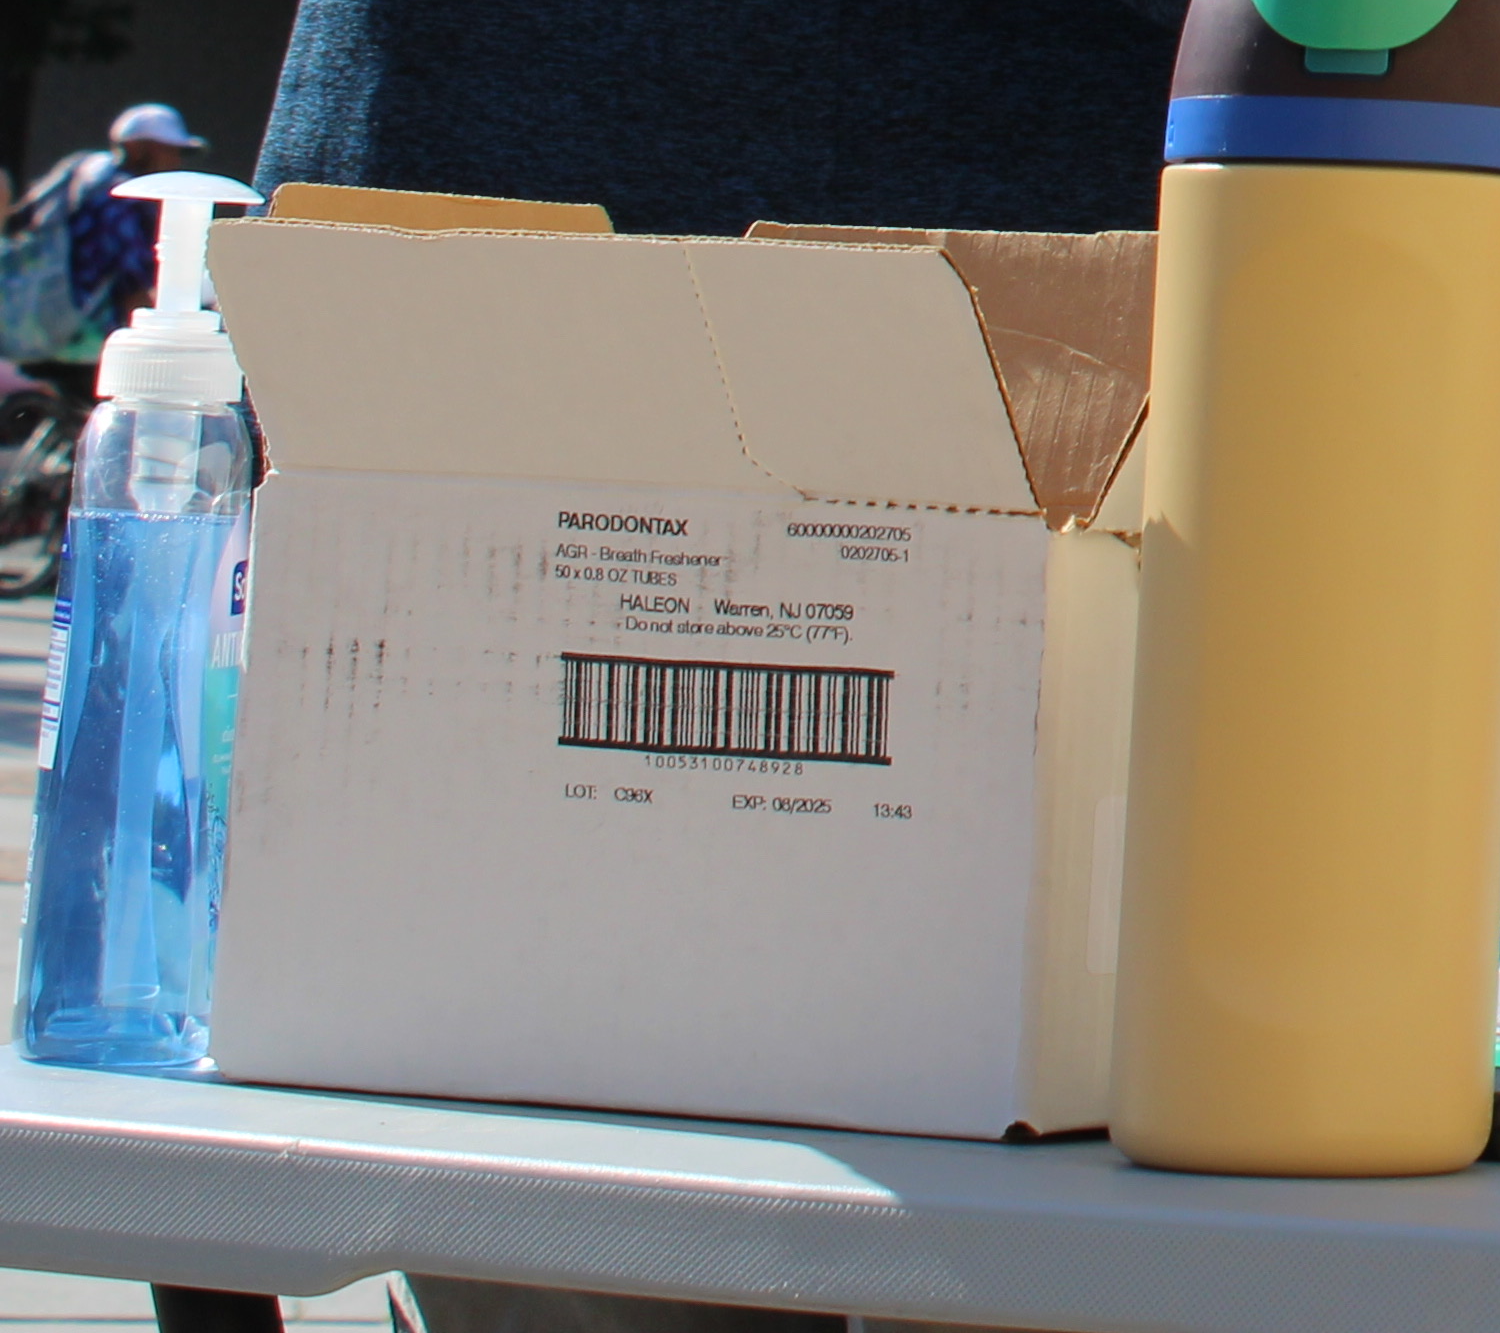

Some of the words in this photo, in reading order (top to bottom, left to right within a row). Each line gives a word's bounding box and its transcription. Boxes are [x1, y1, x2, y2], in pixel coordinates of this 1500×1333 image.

[558, 511, 689, 536] PARODONTAX
[787, 522, 912, 542] 60000000202705
[555, 543, 588, 559] AGR
[600, 546, 647, 562] Breath
[651, 550, 722, 567] Freshener
[841, 545, 909, 563] 0202705-1
[555, 564, 571, 579] 50
[573, 569, 580, 579] x
[584, 566, 604, 581] 0.8
[607, 568, 628, 583] OZ
[632, 569, 678, 587] TUBES
[620, 593, 691, 614] HALEON
[714, 598, 774, 620] Warren,
[779, 601, 801, 619] NJ
[805, 603, 854, 621] 07059
[625, 615, 650, 631] Do
[650, 618, 673, 633] not
[677, 619, 714, 635] store
[716, 621, 764, 637] above
[766, 623, 803, 639] 25°C
[645, 755, 804, 776] 10053100748928
[565, 783, 598, 801] LOT:
[732, 794, 768, 811] EXP:
[873, 803, 913, 820] 13:43
